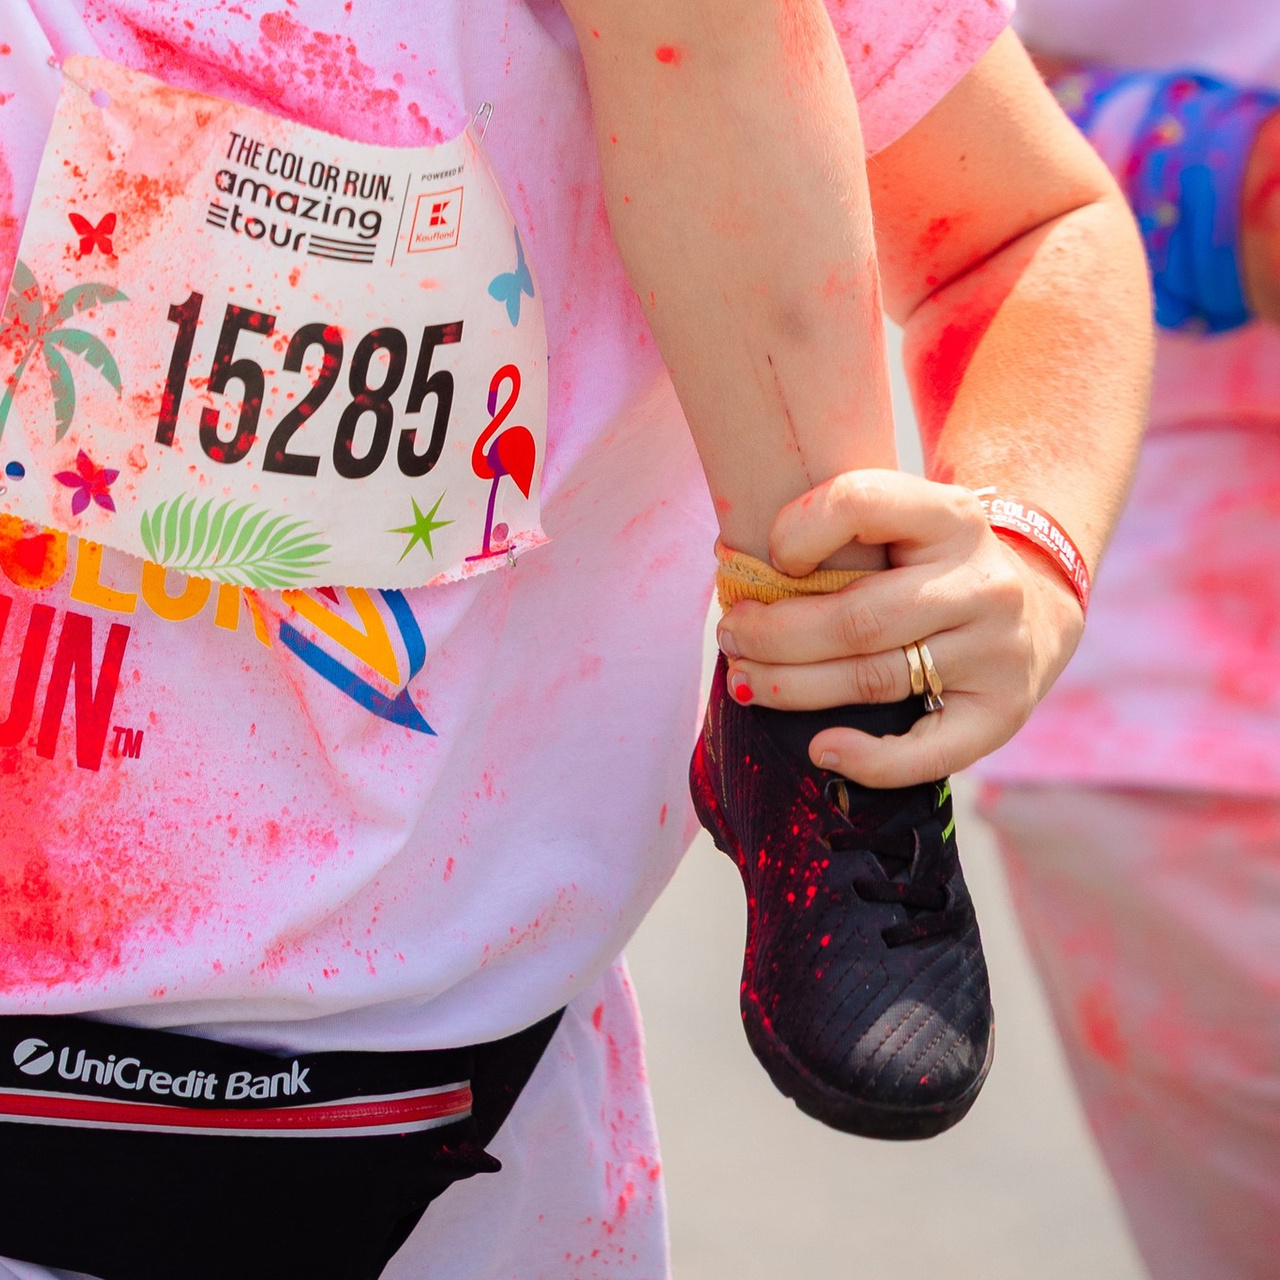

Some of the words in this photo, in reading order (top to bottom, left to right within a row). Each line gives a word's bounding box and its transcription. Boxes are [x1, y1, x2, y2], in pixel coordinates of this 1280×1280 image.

[225, 131, 265, 170] THE
[265, 147, 341, 193] COLOR
[215, 169, 383, 239] amazing
[230, 205, 307, 252] tour
[154, 291, 465, 480] 15285
[991, 499, 1051, 535] COLOR
[1049, 525, 1077, 565] RUN
[57, 1046, 218, 1100] UniCredit
[225, 1060, 312, 1100] Bank
